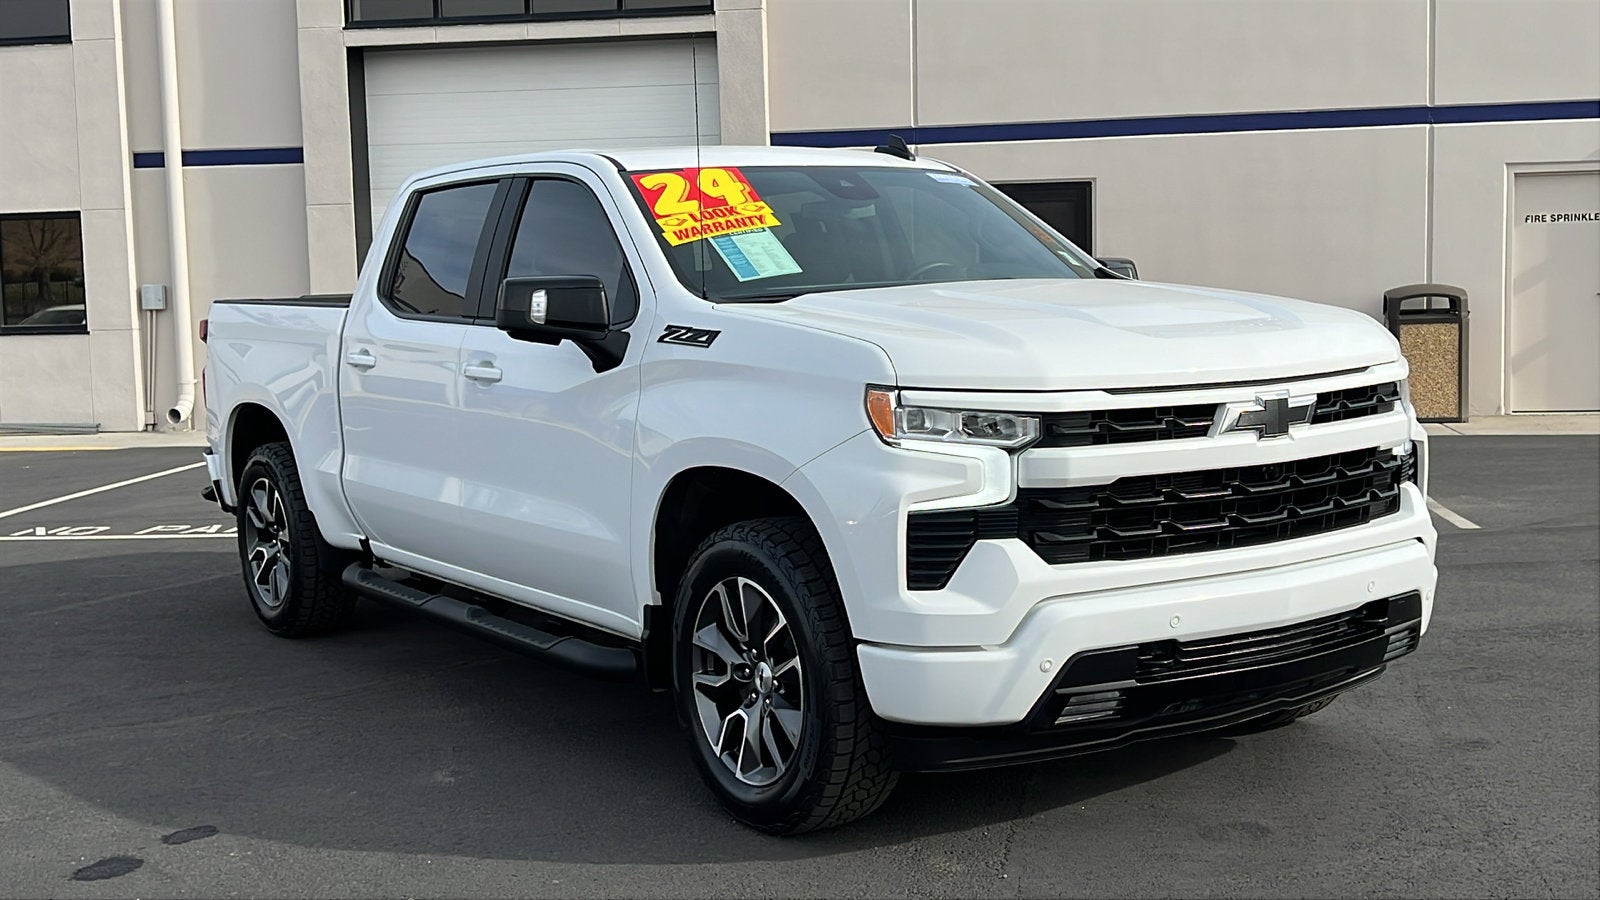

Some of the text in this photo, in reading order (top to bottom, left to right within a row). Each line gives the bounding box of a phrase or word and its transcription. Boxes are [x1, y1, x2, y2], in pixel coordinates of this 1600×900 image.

[640, 168, 751, 216] 24
[689, 206, 741, 223] LOOK
[1525, 214, 1547, 223] FIRE
[673, 214, 767, 242] WARRANTY
[656, 324, 722, 349] Z71
[9, 526, 111, 536] NO
